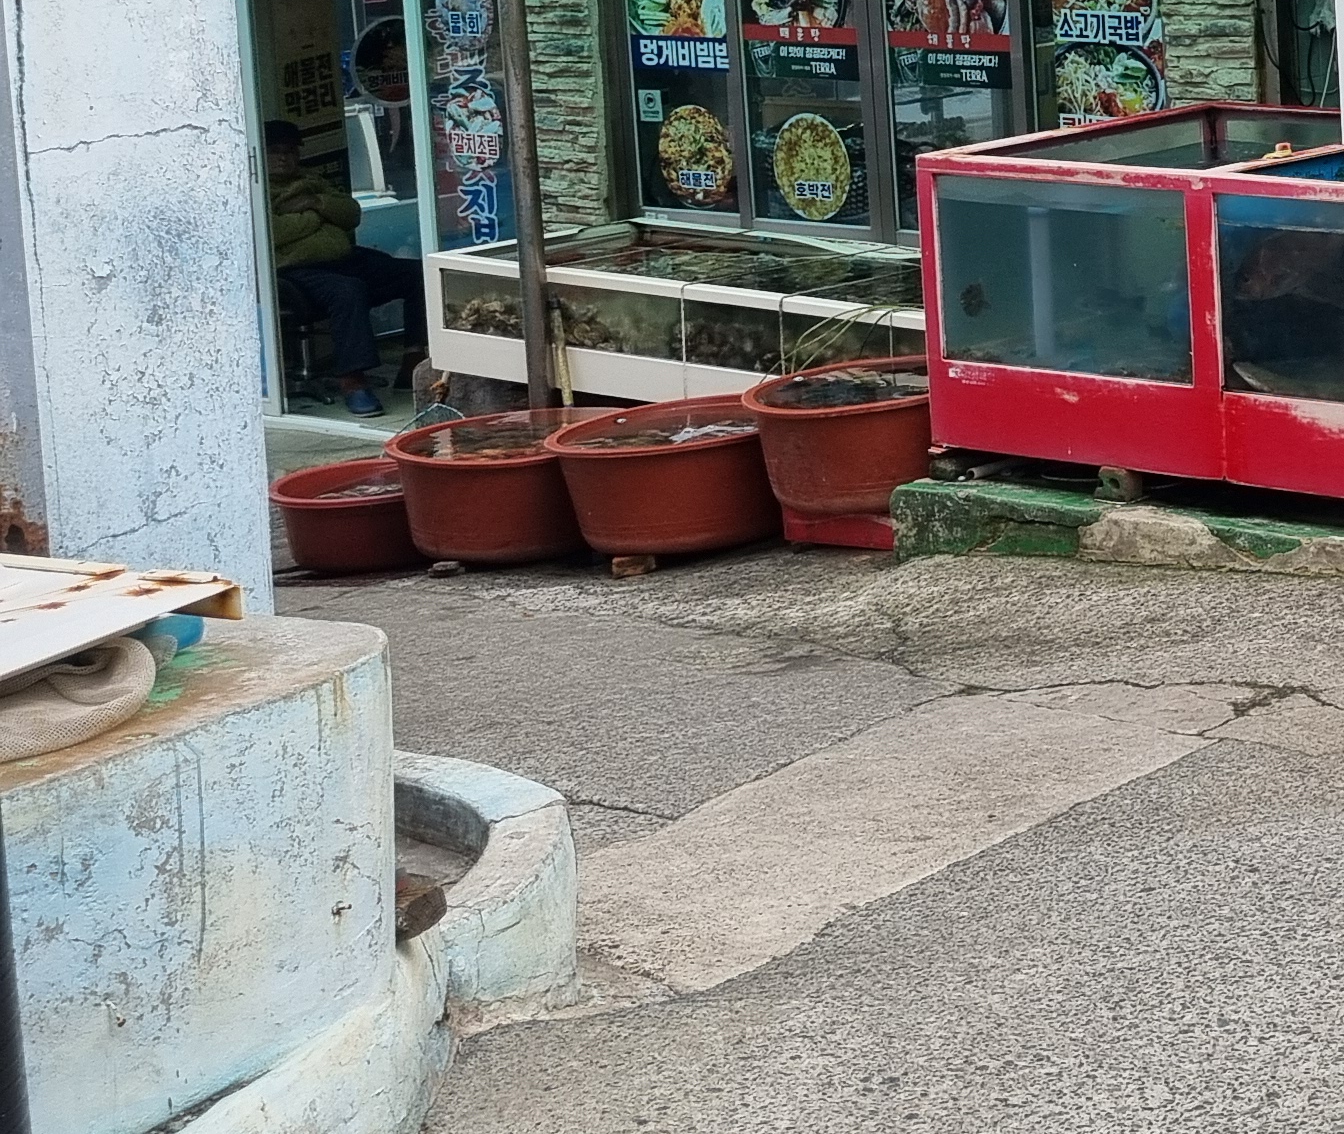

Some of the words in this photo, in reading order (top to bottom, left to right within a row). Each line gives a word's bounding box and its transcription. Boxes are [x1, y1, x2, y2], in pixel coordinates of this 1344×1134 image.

[1059, 12, 1142, 42] 소고기국밥
[810, 61, 837, 75] TERRA
[960, 69, 989, 83] TERRA
[452, 133, 498, 157] 갈치조림
[680, 171, 715, 188] 해물전
[796, 182, 833, 200] 호박전
